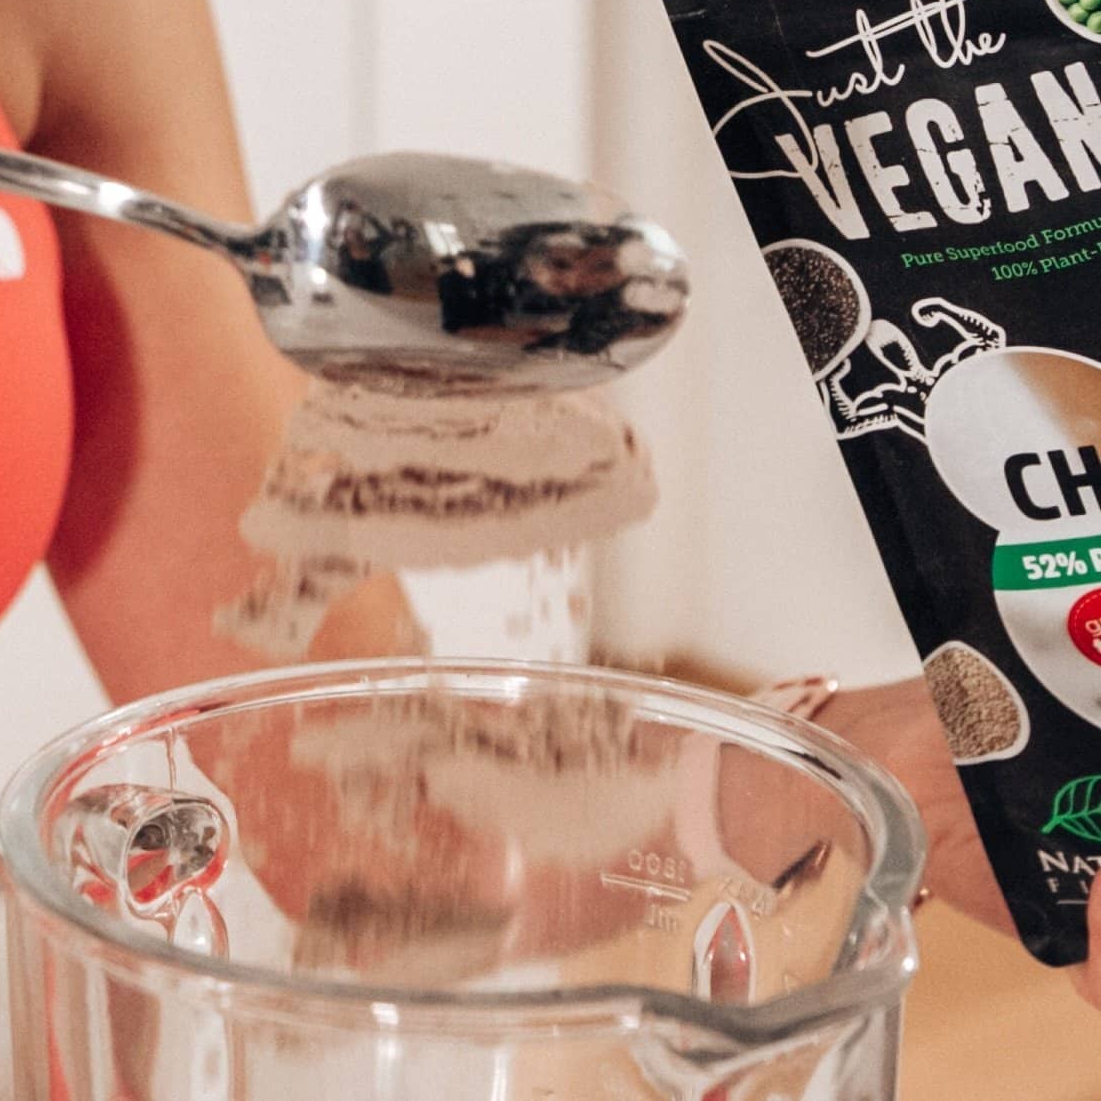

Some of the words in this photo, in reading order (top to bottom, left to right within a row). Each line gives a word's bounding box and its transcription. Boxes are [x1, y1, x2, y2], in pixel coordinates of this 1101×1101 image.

[703, 8, 908, 179] Just
[774, 61, 1101, 241] VEGAN
[901, 252, 945, 268] Pure
[945, 234, 1040, 261] Superfood
[991, 260, 1038, 281] 100%
[1003, 445, 1101, 520] CH
[1022, 551, 1088, 580] 52%
